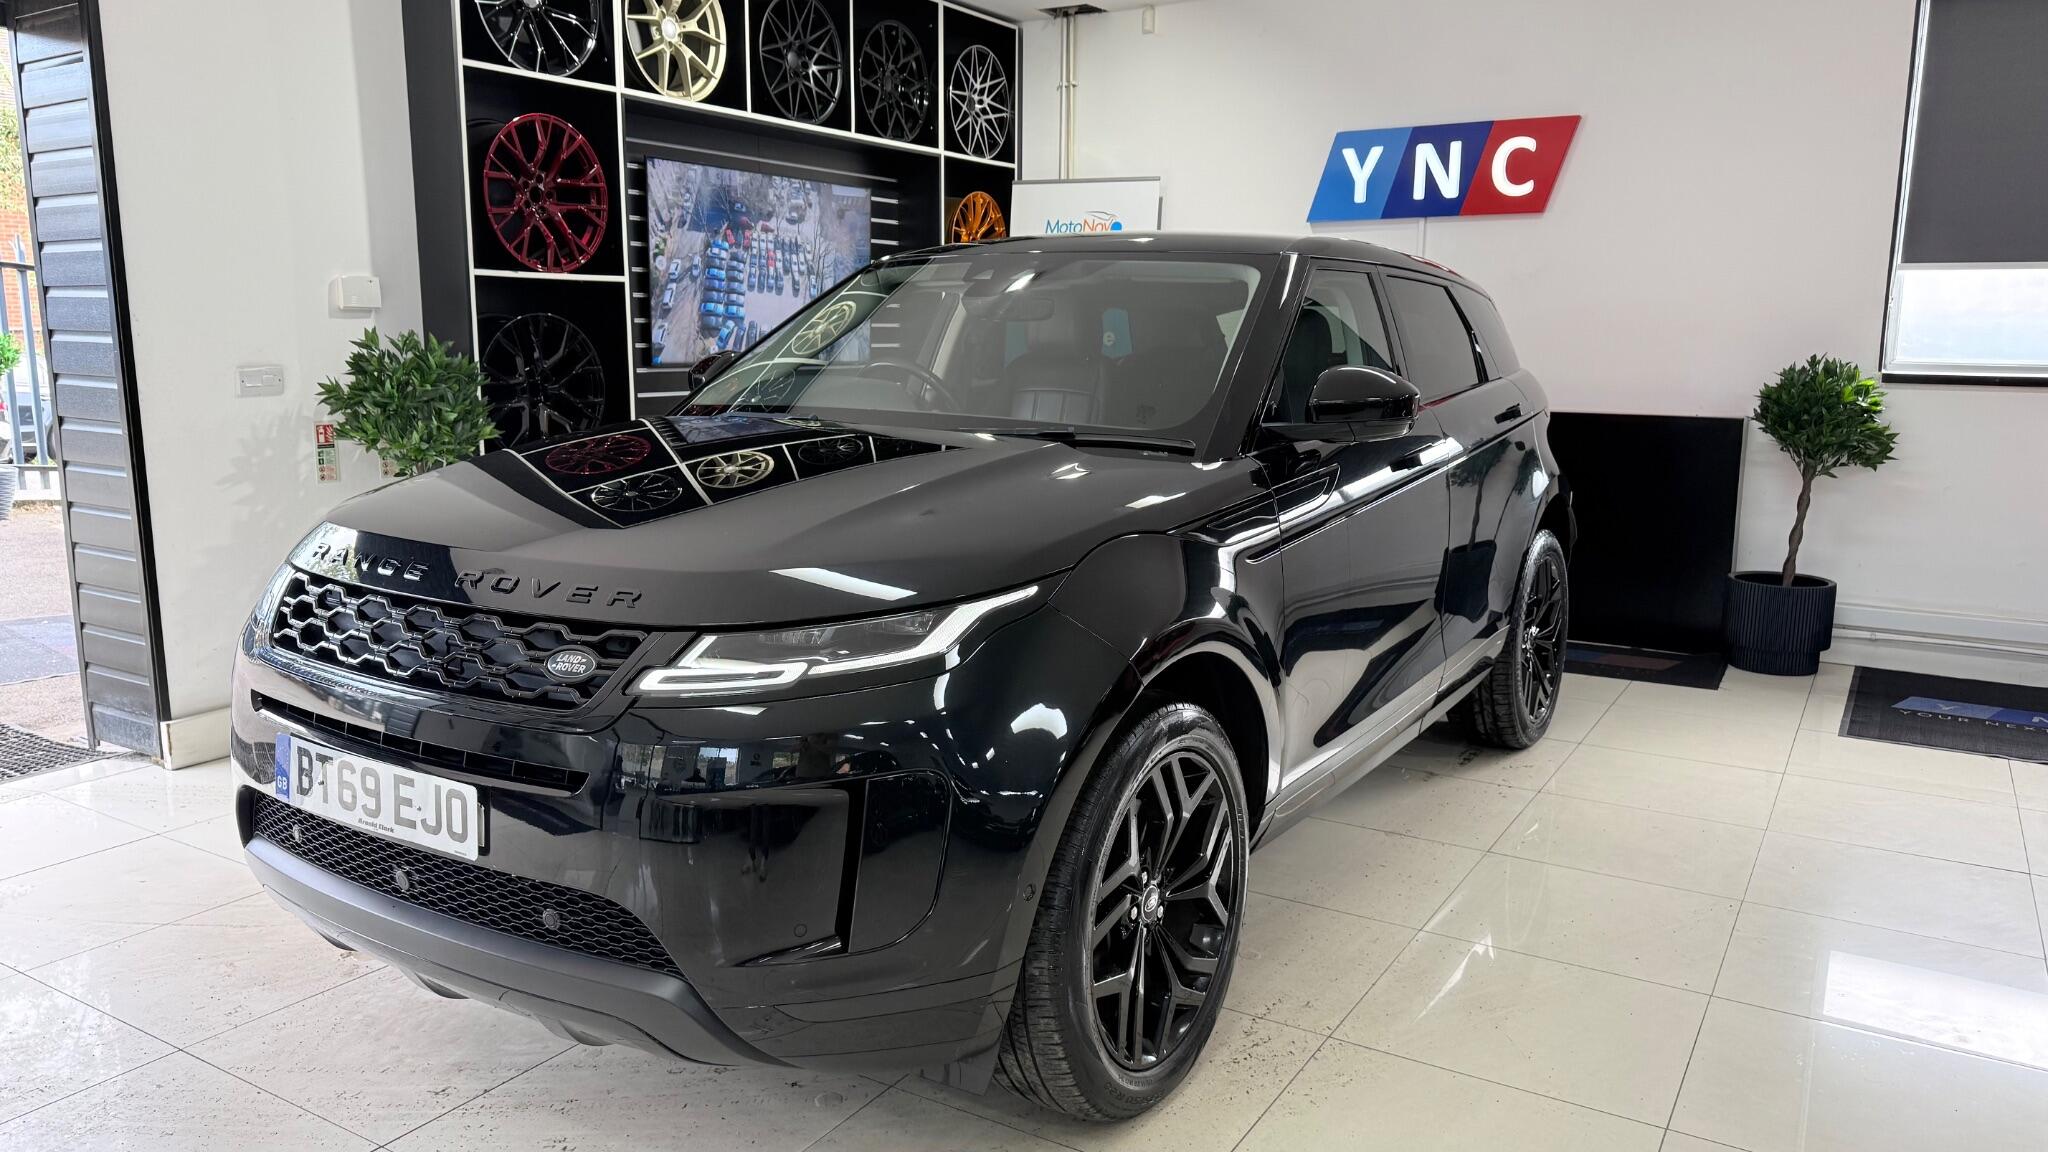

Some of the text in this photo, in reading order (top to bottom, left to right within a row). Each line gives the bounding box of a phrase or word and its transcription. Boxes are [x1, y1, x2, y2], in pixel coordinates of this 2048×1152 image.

[1341, 135, 1537, 204] YNC
[312, 543, 642, 608] RANGE ROVER
[555, 652, 582, 664] LAND
[554, 661, 586, 674] ROVER
[1899, 709, 1969, 722] YOUR
[276, 775, 288, 790] GB
[296, 745, 469, 844] BT69 EJO
